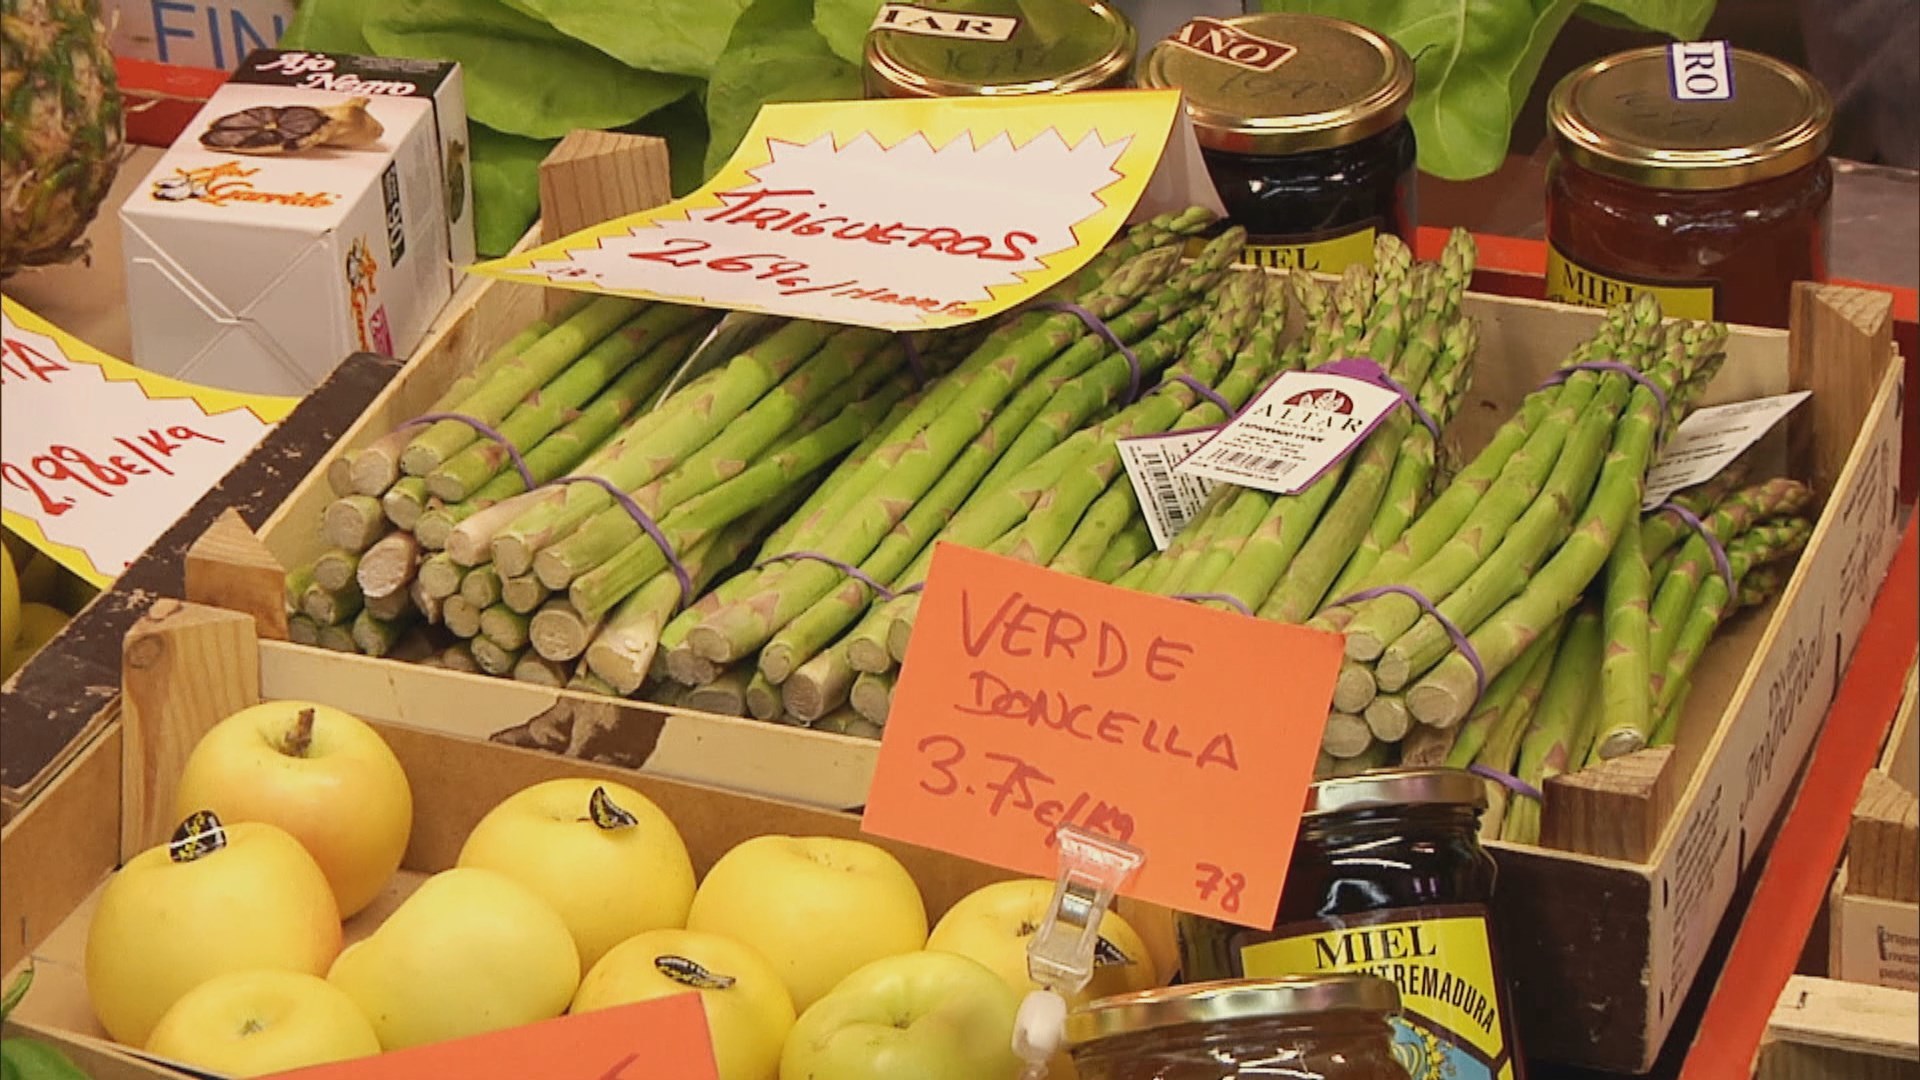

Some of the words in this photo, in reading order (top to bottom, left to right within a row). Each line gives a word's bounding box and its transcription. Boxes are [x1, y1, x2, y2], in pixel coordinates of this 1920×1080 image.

[255, 52, 336, 75] Ajo
[296, 72, 416, 96] Negro
[1683, 41, 1719, 95] RO
[703, 189, 1038, 262] TRIGUEROS
[1238, 248, 1320, 270] IEL
[1253, 403, 1364, 433] ALTAR
[961, 589, 1195, 682] VERDE
[953, 669, 1240, 772] DONCELLA
[1195, 862, 1247, 914] 78
[1311, 924, 1437, 969] MIEL
